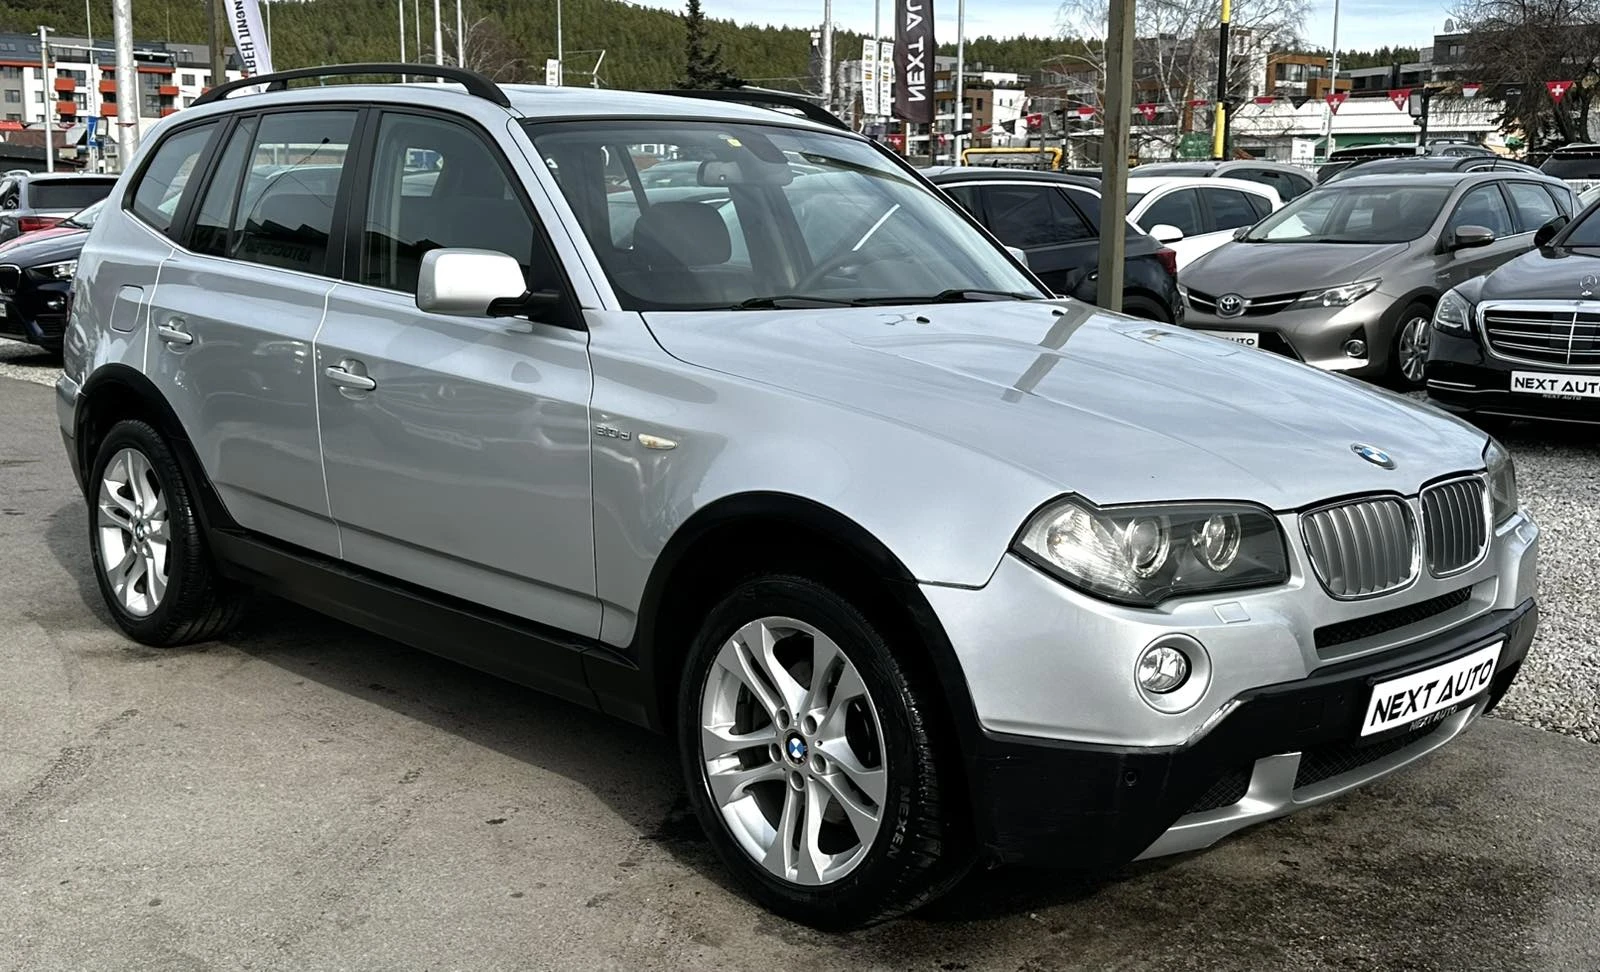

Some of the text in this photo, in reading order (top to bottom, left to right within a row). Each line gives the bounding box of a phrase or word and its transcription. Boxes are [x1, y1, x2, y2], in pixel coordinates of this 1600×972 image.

[1514, 376, 1559, 391] NEXT
[1370, 658, 1494, 727] NEXT AUTO
[1408, 704, 1458, 732] NEXT AUTO
[886, 784, 912, 860] NEXEN
